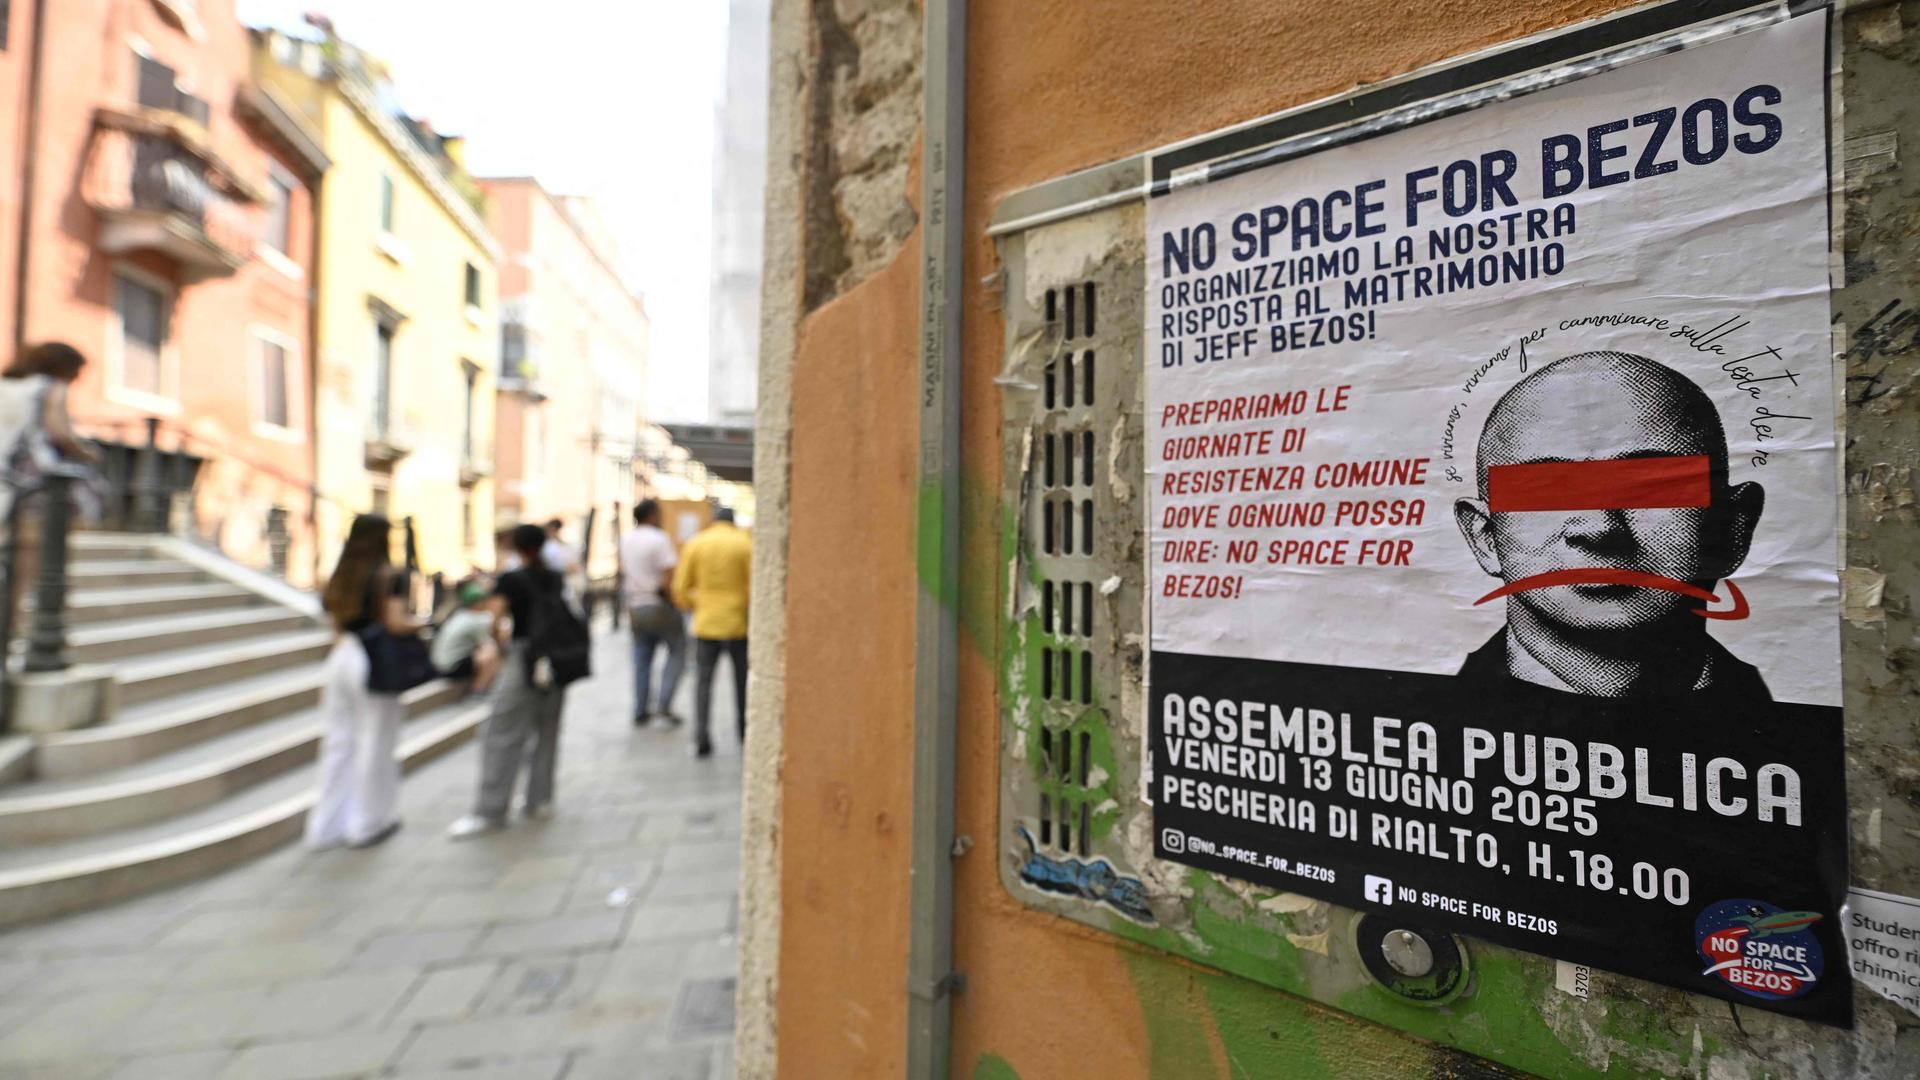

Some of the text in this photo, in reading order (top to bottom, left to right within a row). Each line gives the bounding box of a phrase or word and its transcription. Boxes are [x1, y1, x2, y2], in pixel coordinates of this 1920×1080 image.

[1163, 84, 1783, 278] NO SPACE FOR BEZOS
[1162, 202, 1576, 310] ORGANIZZIAMO LA NOSTRA
[1162, 242, 1564, 339] RISPOSTA AL MATRIMONIO
[1162, 310, 1376, 369] DI JEFF BEZOS!
[1559, 311, 1670, 331] camminare
[1671, 315, 1750, 355] sulla
[1520, 327, 1549, 373] per
[1161, 385, 1352, 428] PREPARIAMO LE
[1749, 406, 1812, 443] dei
[1162, 428, 1306, 461] GIORNATE DI
[1751, 449, 1768, 468] re
[1162, 458, 1430, 495] RESISTENZA COMUNE
[1445, 466, 1462, 482] se
[1162, 499, 1426, 529] DOVE OGNUNO POSSA
[1162, 540, 1414, 566] DIRE: NO SPACE FOR
[1162, 575, 1243, 599] BEZOS!
[1163, 692, 1801, 827] ASSEMBLEA PUBBLICA
[1164, 736, 1598, 836] VENERDI 13 GIUGNO 2025
[1163, 775, 1690, 907] PESCHERIA DI RIALTO, H.18.00
[1188, 836, 1336, 884] @NO_SPACE_FOR_BEZOS
[1399, 886, 1417, 903] NO
[1422, 891, 1467, 916] SPACE
[1473, 904, 1501, 923] FOR
[1507, 910, 1558, 936] BEZOS
[1711, 937, 1807, 963] NO SPACE
[1743, 956, 1773, 971] FOR
[1852, 938, 1920, 968] offro ri
[1729, 967, 1792, 991] BEZOS
[1853, 959, 1920, 988] chimic
